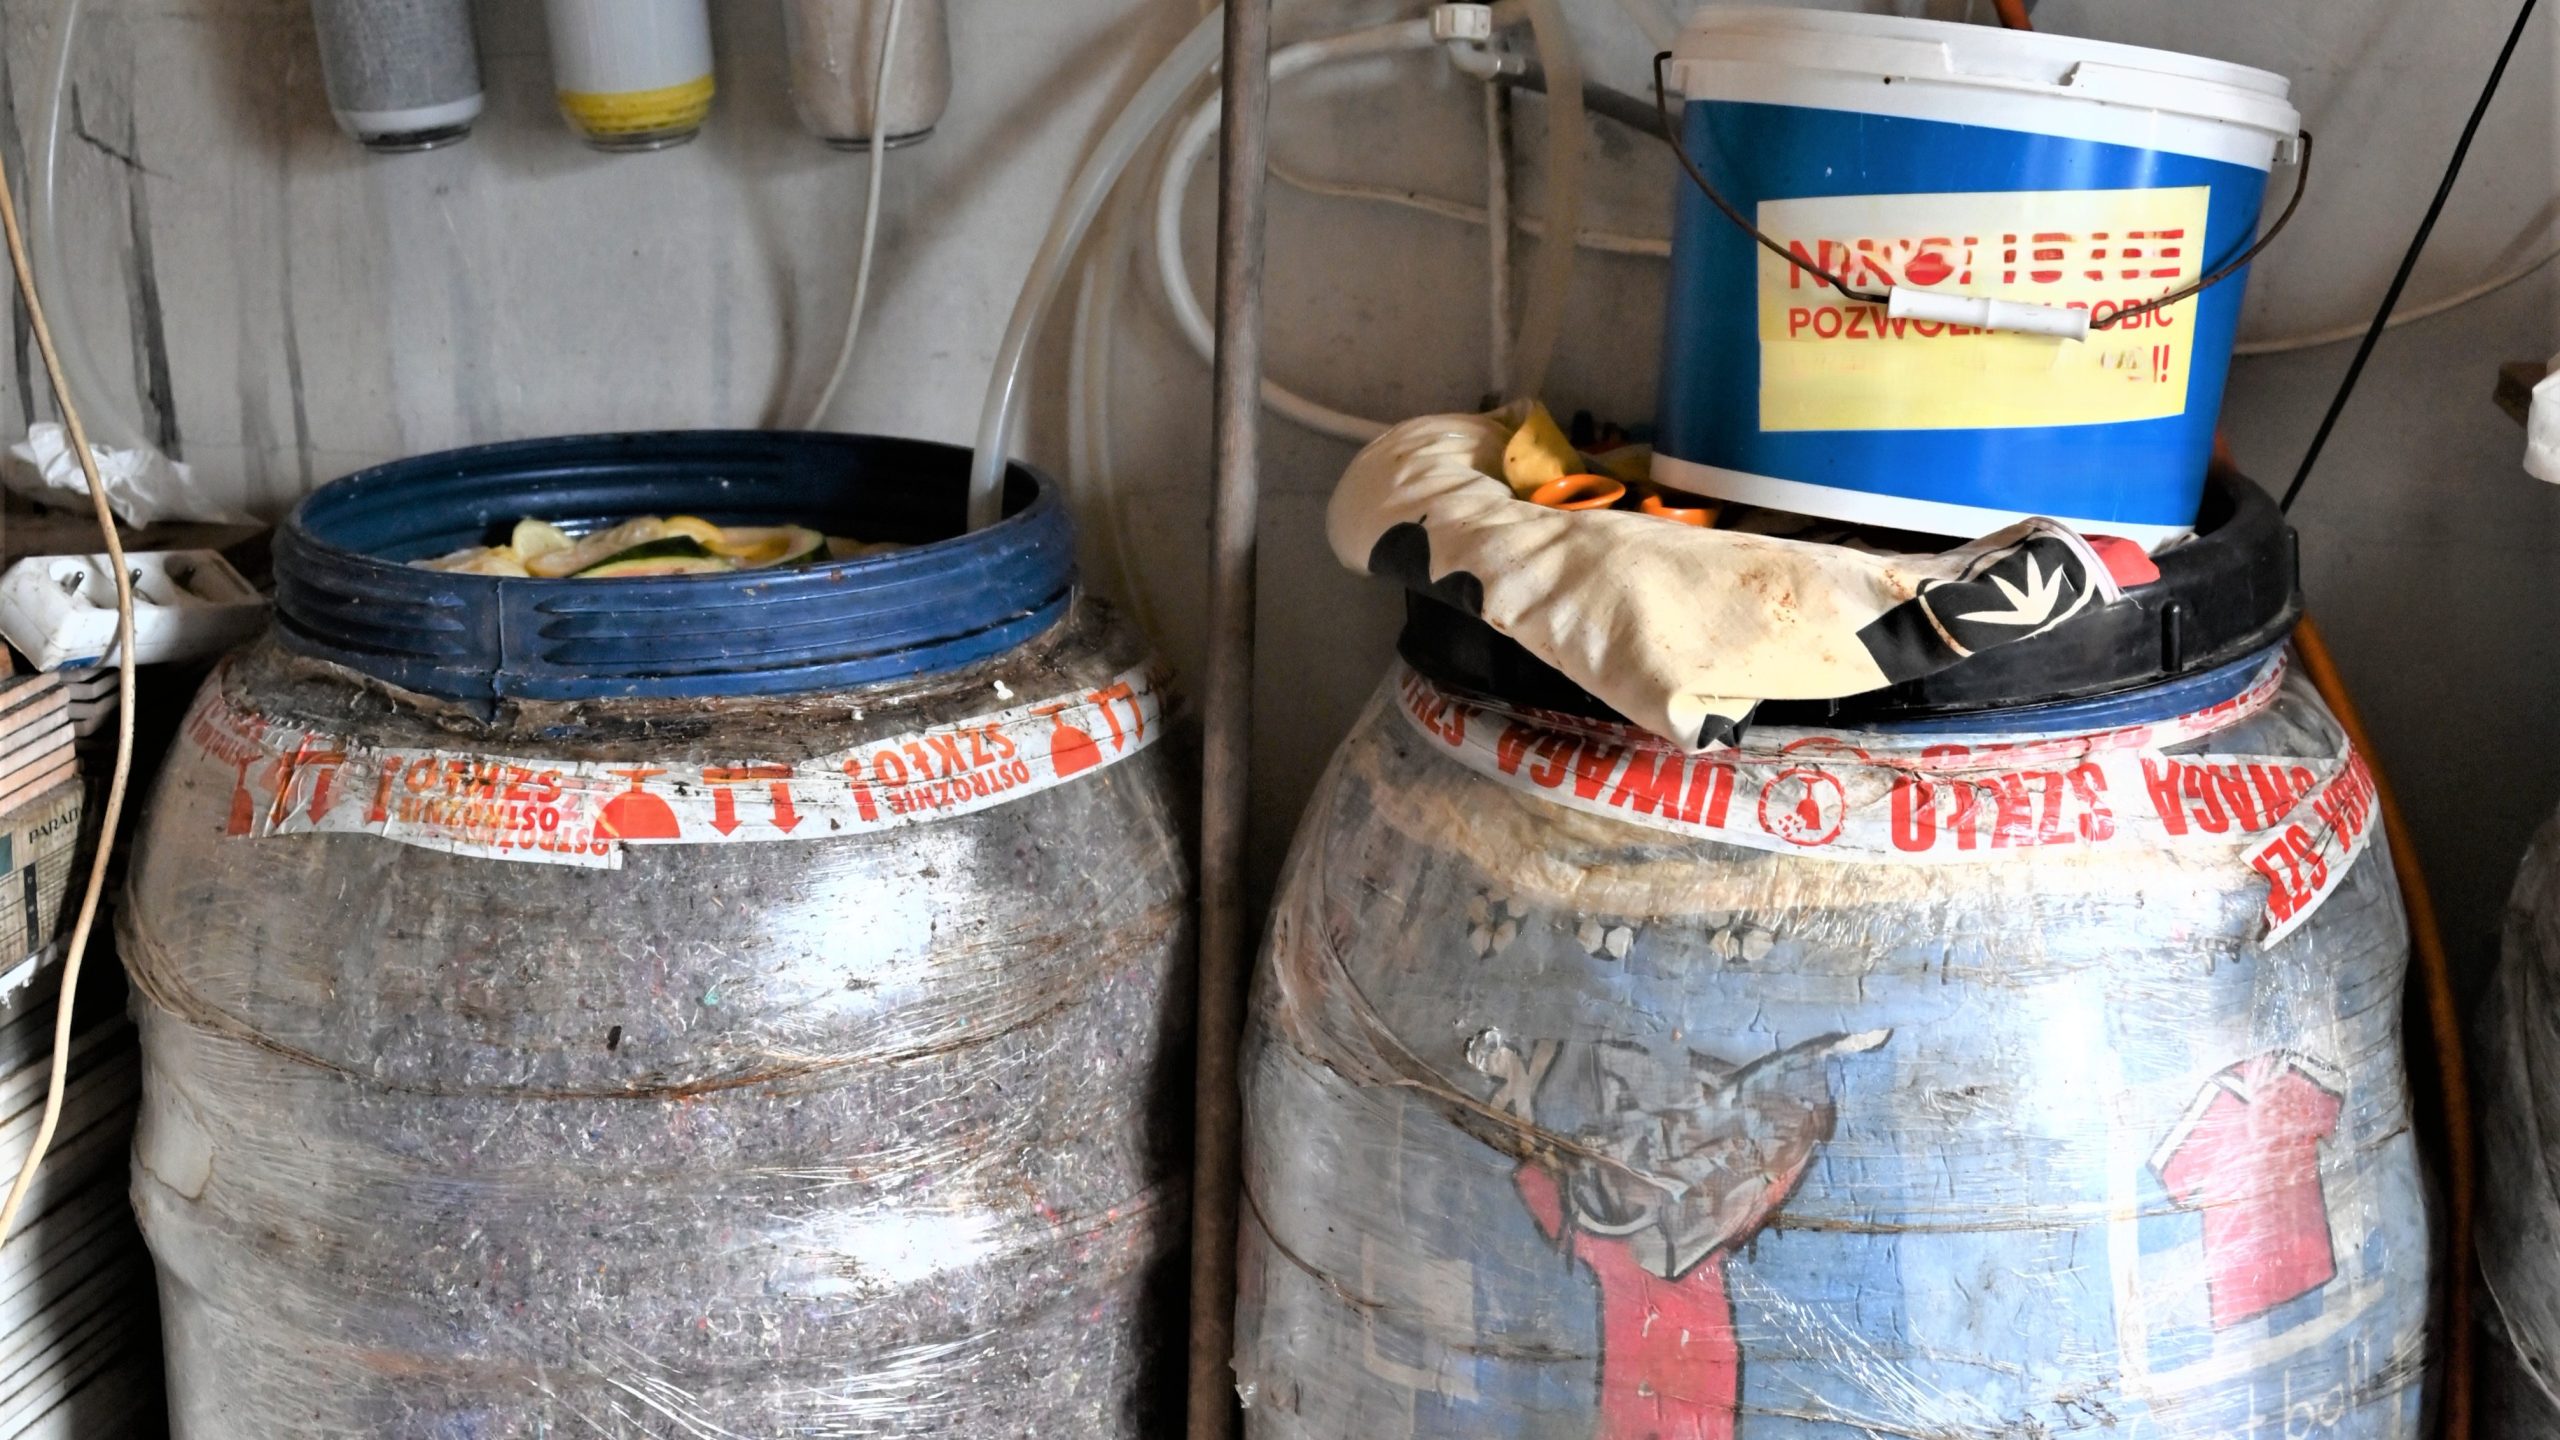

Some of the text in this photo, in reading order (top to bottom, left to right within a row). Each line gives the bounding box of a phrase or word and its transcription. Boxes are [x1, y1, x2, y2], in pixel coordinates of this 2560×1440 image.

[2066, 286, 2174, 331] OBIĆ
[886, 760, 1031, 815] OSTROŻNIE
[1498, 722, 1735, 830] UWAGA
[1891, 763, 2115, 853] SZKŁO
